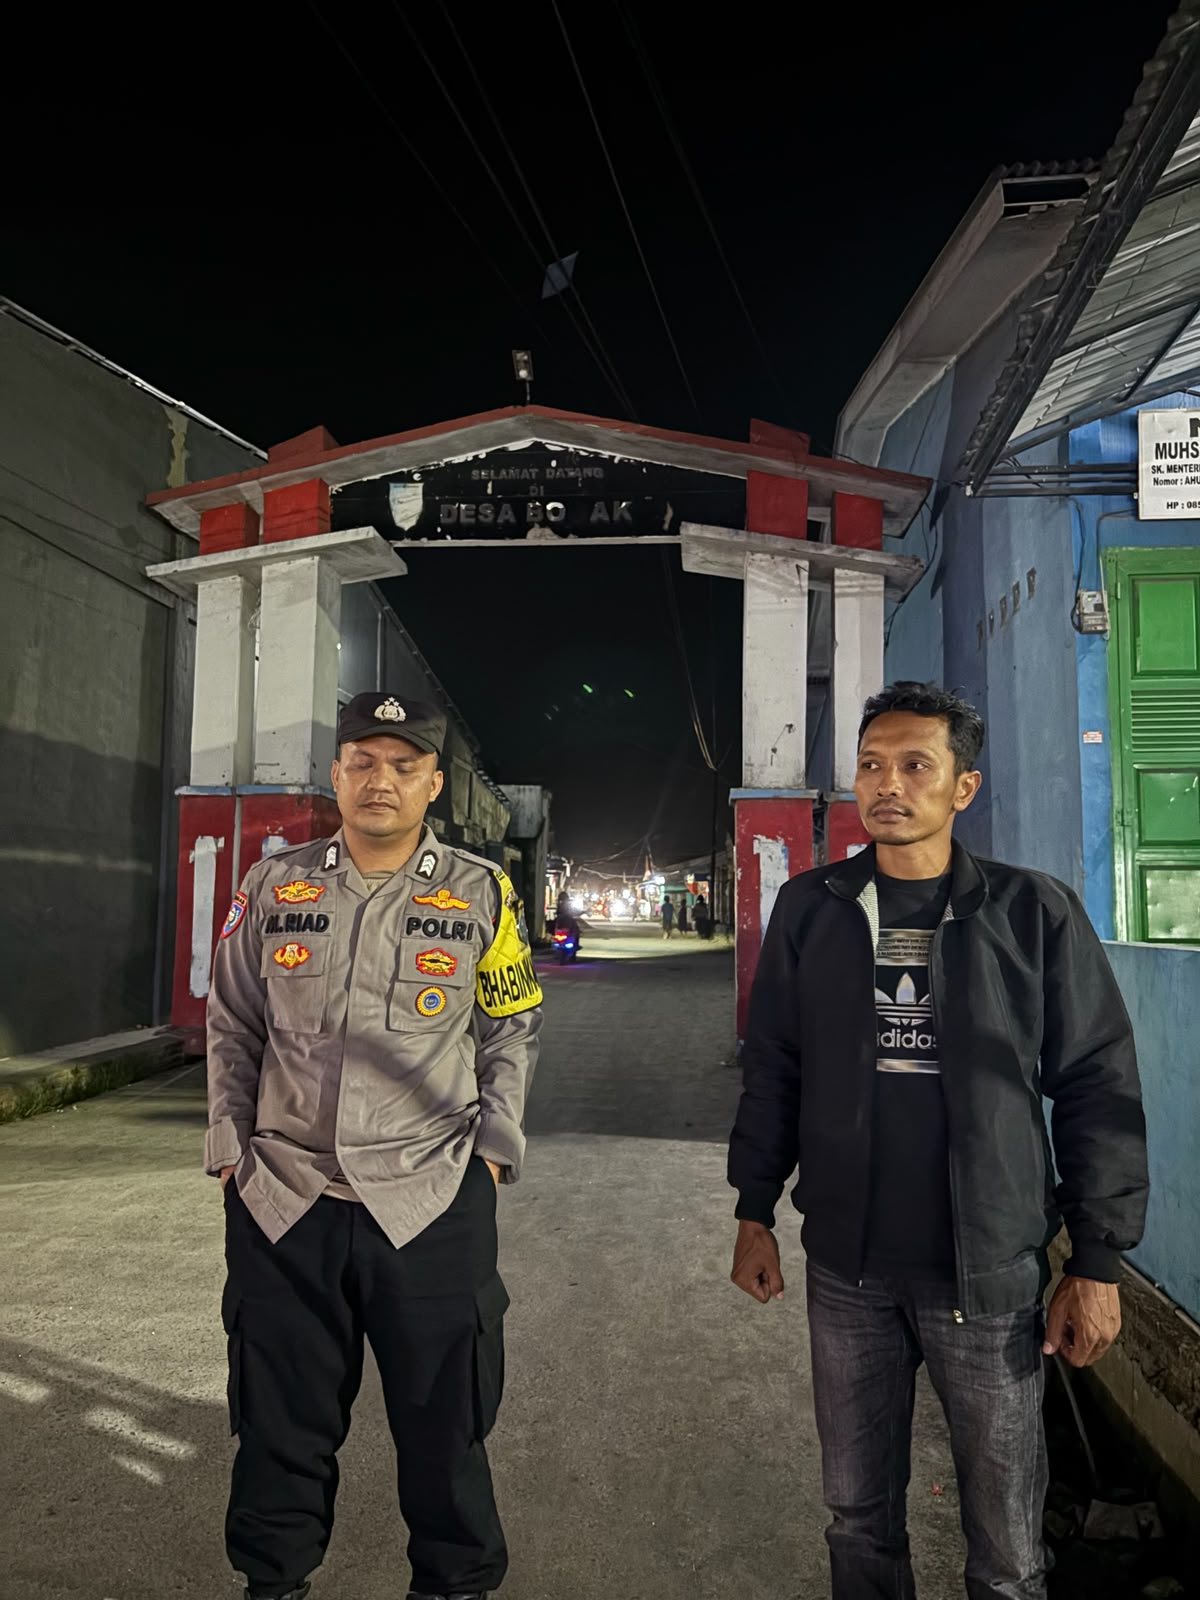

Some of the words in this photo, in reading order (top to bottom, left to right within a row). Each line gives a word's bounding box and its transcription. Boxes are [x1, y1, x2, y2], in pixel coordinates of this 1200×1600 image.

[1155, 441, 1200, 460] MUHS
[471, 468, 540, 480] SELAMAT
[545, 467, 605, 479] DATANG
[1151, 464, 1165, 475] SK.
[1153, 477, 1179, 486] Nomor
[529, 486, 545, 497] DI
[1166, 501, 1179, 510] HP
[440, 503, 517, 524] DESA
[406, 917, 475, 941] POLRI
[877, 1028, 937, 1049] dida
